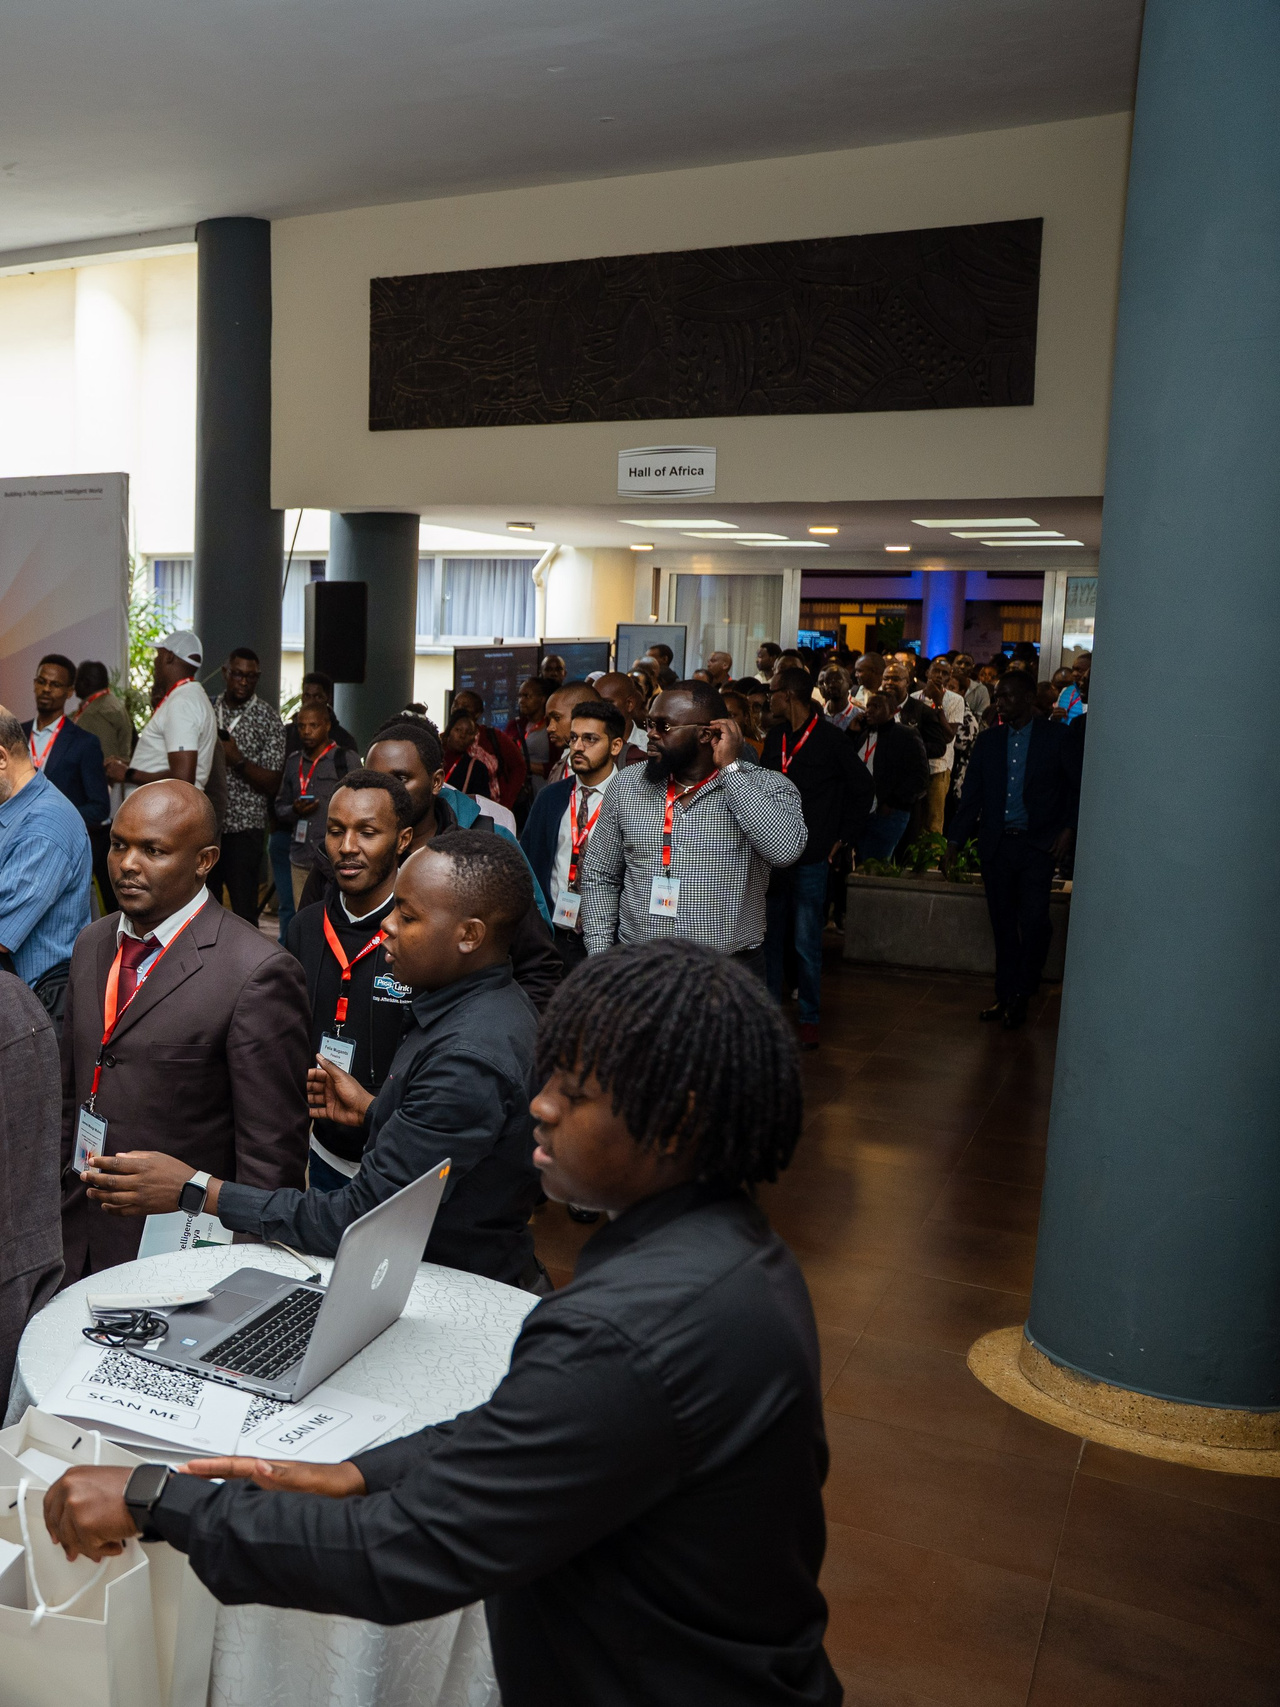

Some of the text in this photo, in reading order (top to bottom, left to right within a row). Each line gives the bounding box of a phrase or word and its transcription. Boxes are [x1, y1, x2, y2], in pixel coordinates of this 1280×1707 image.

[628, 466, 705, 477] Hall of Africa
[88, 1392, 181, 1422] SCAN ME
[278, 1412, 334, 1446] SCAN ME
